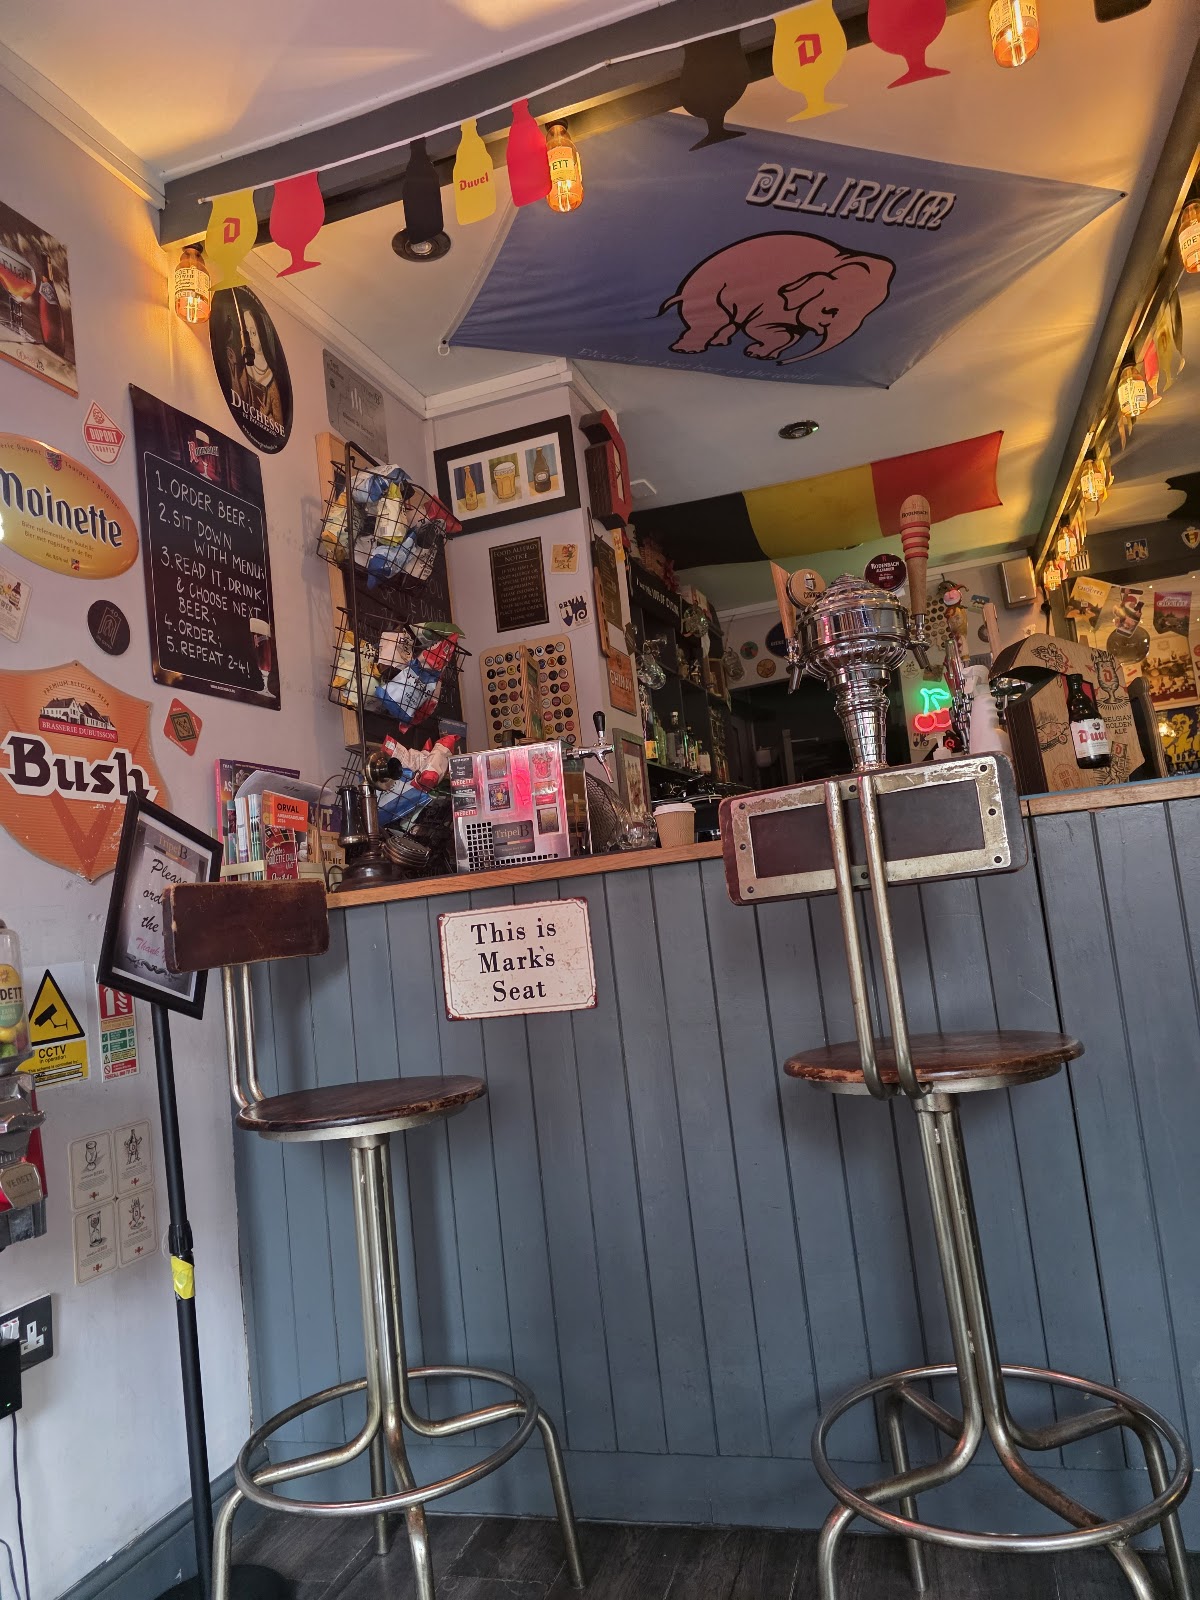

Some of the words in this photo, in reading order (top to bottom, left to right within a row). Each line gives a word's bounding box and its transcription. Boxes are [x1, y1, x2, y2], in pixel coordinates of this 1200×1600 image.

[552, 159, 569, 171] ETT
[459, 172, 489, 191] Duvel
[745, 162, 958, 231] DELIRIUM
[231, 388, 286, 438] DUCHESSE
[89, 427, 119, 444] DUPONT
[156, 470, 168, 494] 1.
[170, 479, 214, 515] ORDER
[0, 467, 122, 549] Moinette
[159, 502, 171, 523] 2.
[173, 510, 192, 531] SIT
[197, 521, 232, 551] DOWN
[194, 539, 228, 565] WITH
[504, 553, 528, 562] NOTICE
[160, 546, 174, 569] 3.
[174, 553, 206, 580] READ
[189, 582, 228, 611] CHOOSE
[232, 601, 262, 619] NEXT
[166, 635, 178, 653] 5.
[180, 640, 223, 667] REPEAT
[43, 680, 69, 695] PREMIUM
[70, 680, 97, 695] BELGIAN
[42, 721, 78, 734] BRASSERIE
[79, 725, 116, 740] DUBUISSON
[1114, 727, 1128, 735] ALE
[7, 735, 150, 799] Bush
[276, 803, 300, 814] ORVAL
[143, 889, 163, 905] ord
[141, 915, 159, 933] the
[470, 921, 526, 945] This
[536, 917, 557, 938] is
[136, 936, 161, 957] Thank
[477, 945, 556, 974] Mark's
[0, 986, 22, 1001] DETT
[493, 980, 547, 1002] Seat
[38, 1044, 67, 1059] CCTV
[45, 1055, 67, 1064] operation
